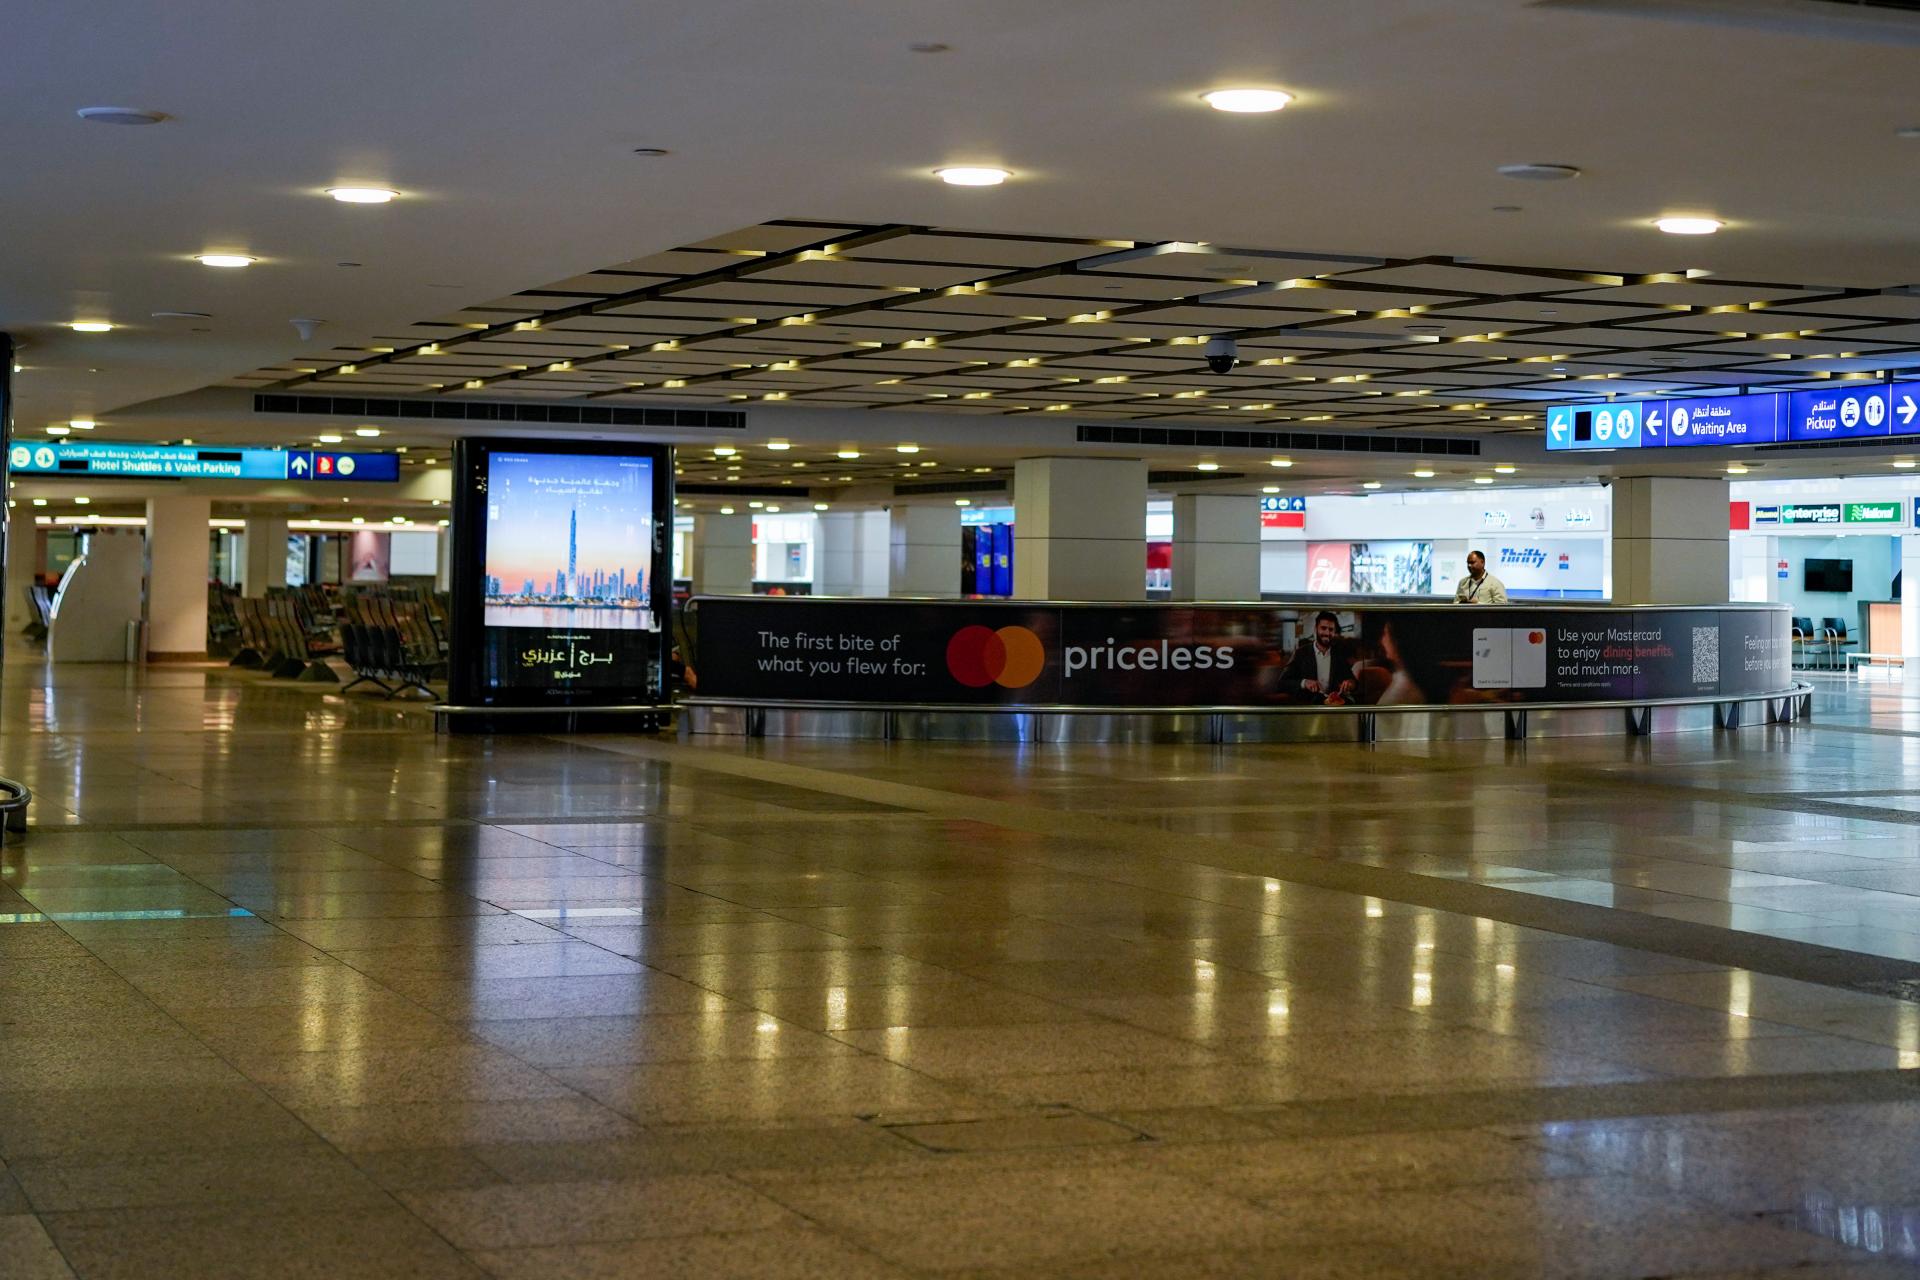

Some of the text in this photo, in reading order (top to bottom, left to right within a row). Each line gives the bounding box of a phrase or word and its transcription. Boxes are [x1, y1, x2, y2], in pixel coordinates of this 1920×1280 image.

[1710, 407, 1731, 417] منطقة
[1811, 400, 1836, 415] استلام
[1692, 421, 1747, 437] Waiting Area
[1806, 417, 1836, 431] Pickup
[92, 460, 241, 476] Hotel Shuttles & Valet Parking
[1783, 506, 1839, 521] enterprise
[1862, 507, 1895, 519] National
[1501, 547, 1548, 568] Thrifty
[757, 631, 901, 651] The first bite of
[1557, 627, 1662, 644] Use your Mastercard
[522, 648, 613, 666] برج عزيزي
[1064, 637, 1234, 678] priceless
[1557, 646, 1570, 658] to
[1572, 645, 1601, 661] enjoy
[1603, 645, 1633, 660] dining
[757, 655, 926, 677] what you flew for:
[1557, 661, 1641, 675] and much more.
